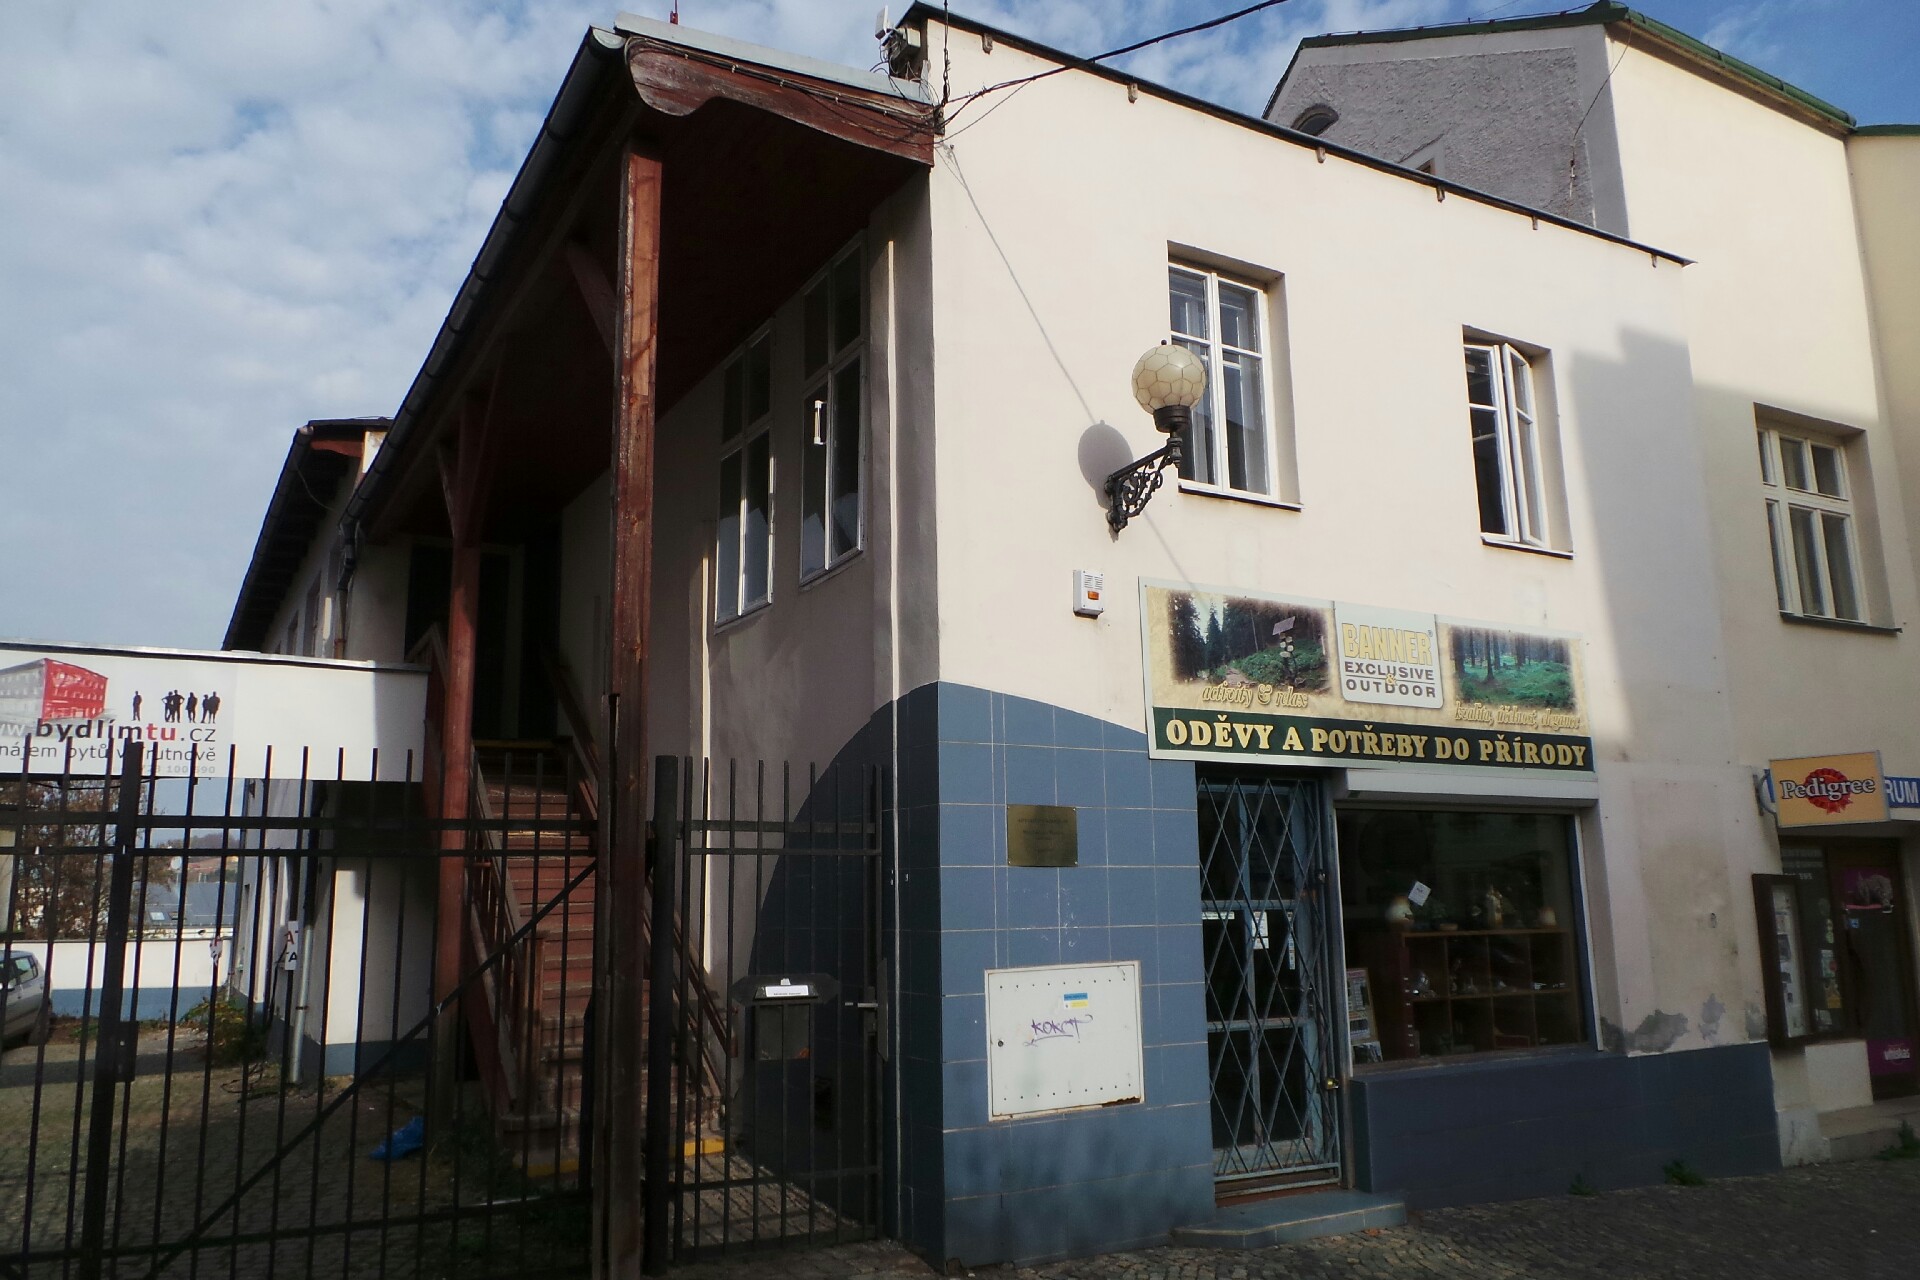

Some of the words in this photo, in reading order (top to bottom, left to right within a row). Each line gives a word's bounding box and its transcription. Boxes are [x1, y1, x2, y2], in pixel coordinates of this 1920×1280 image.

[1341, 622, 1433, 667] BANNER
[1344, 660, 1435, 681] EXCLUSIVE
[1202, 681, 1253, 708] activity
[1257, 683, 1273, 705] &
[1346, 678, 1436, 698] OUTDOOR
[1166, 714, 1275, 751] ODĚVY
[1283, 726, 1305, 751] A
[1311, 725, 1429, 759] POTŘEBY
[1435, 737, 1470, 760] DO
[1479, 734, 1587, 767] PŘÍRODY
[142, 747, 216, 761] rutnově
[1780, 776, 1876, 801] Pedigree
